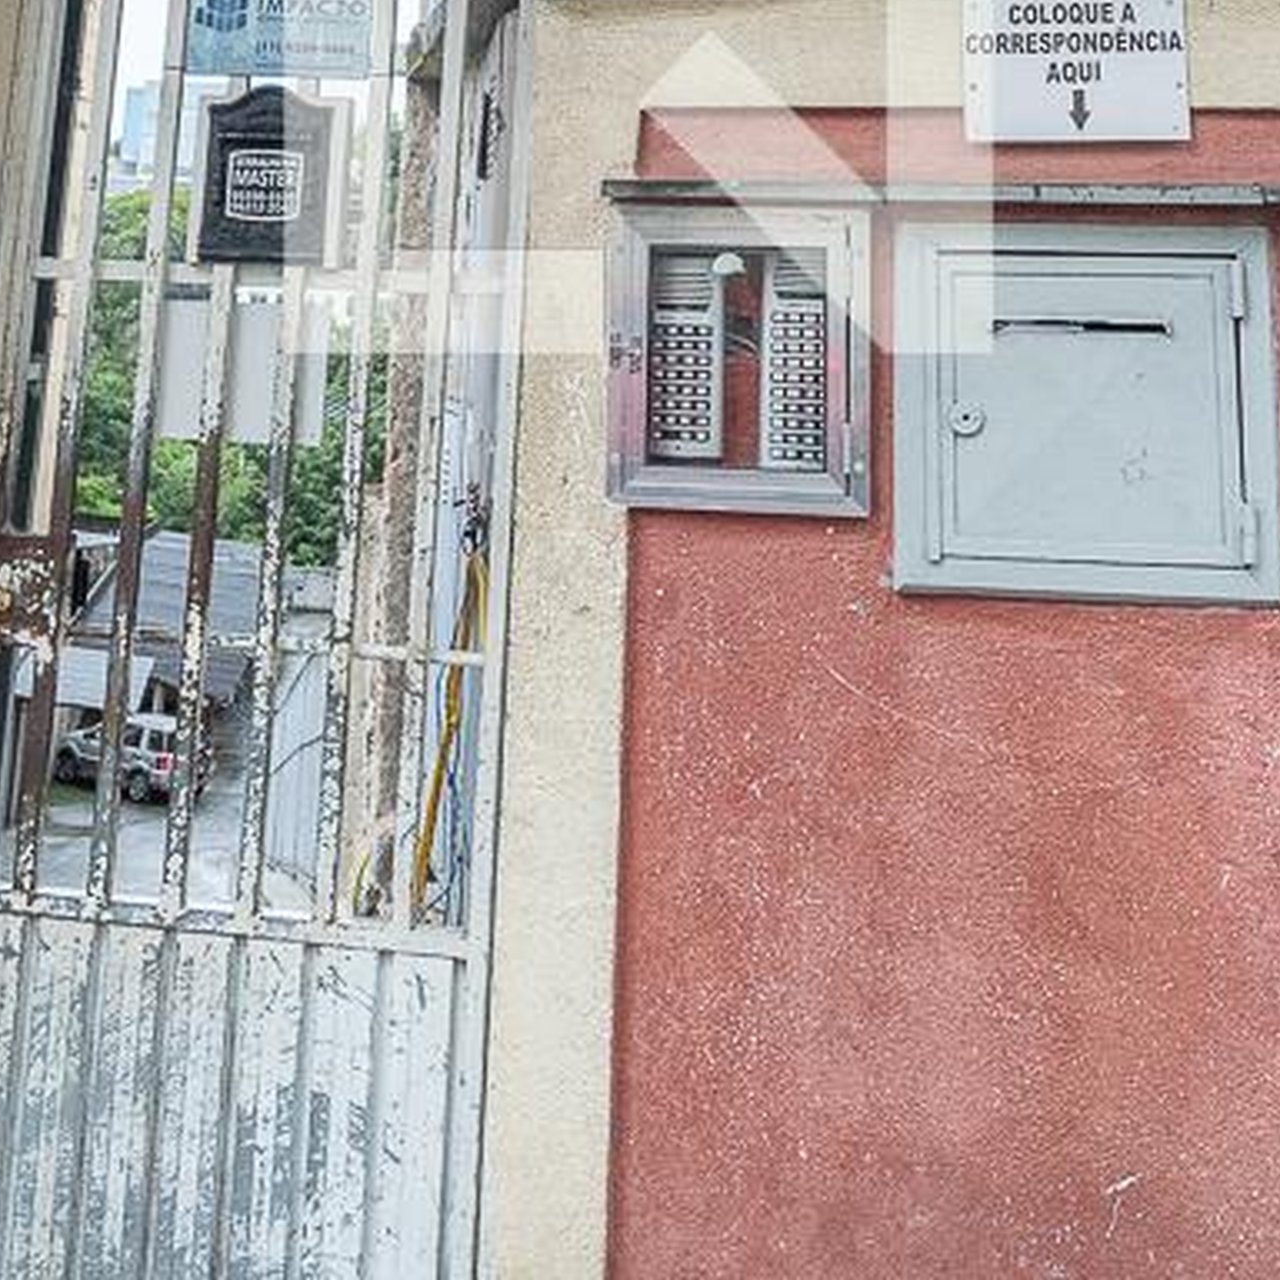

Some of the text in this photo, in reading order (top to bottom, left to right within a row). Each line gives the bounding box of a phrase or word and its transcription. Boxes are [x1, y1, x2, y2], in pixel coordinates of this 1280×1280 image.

[1008, 2, 1138, 24] COLOQUE A
[965, 27, 1185, 55] CORRESPONDÊNCIA
[1045, 62, 1103, 84] AQUI
